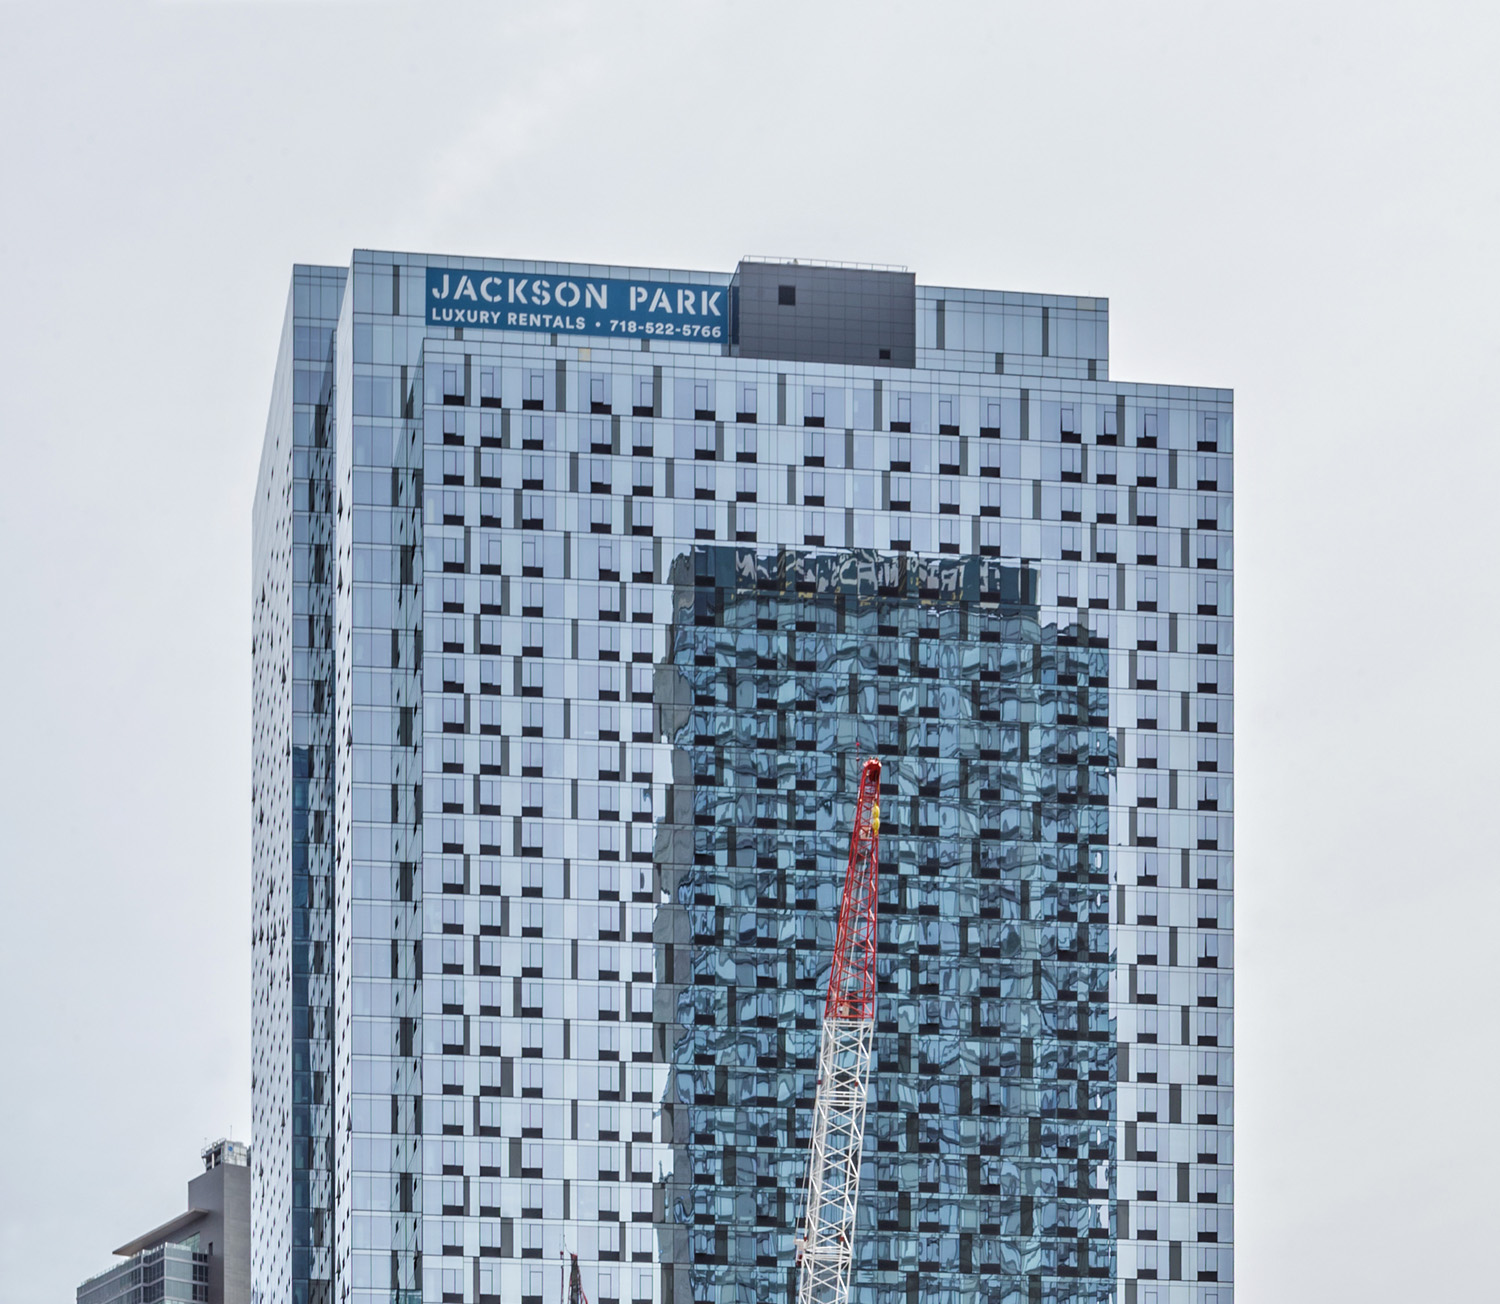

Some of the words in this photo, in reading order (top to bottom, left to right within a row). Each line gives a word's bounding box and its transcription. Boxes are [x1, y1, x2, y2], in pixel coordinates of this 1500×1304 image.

[432, 274, 608, 309] JACKSON
[629, 286, 721, 316] PARK
[432, 307, 501, 324] LUXURY
[507, 312, 586, 330] RENTALS
[609, 319, 721, 338] 718-522-5766
